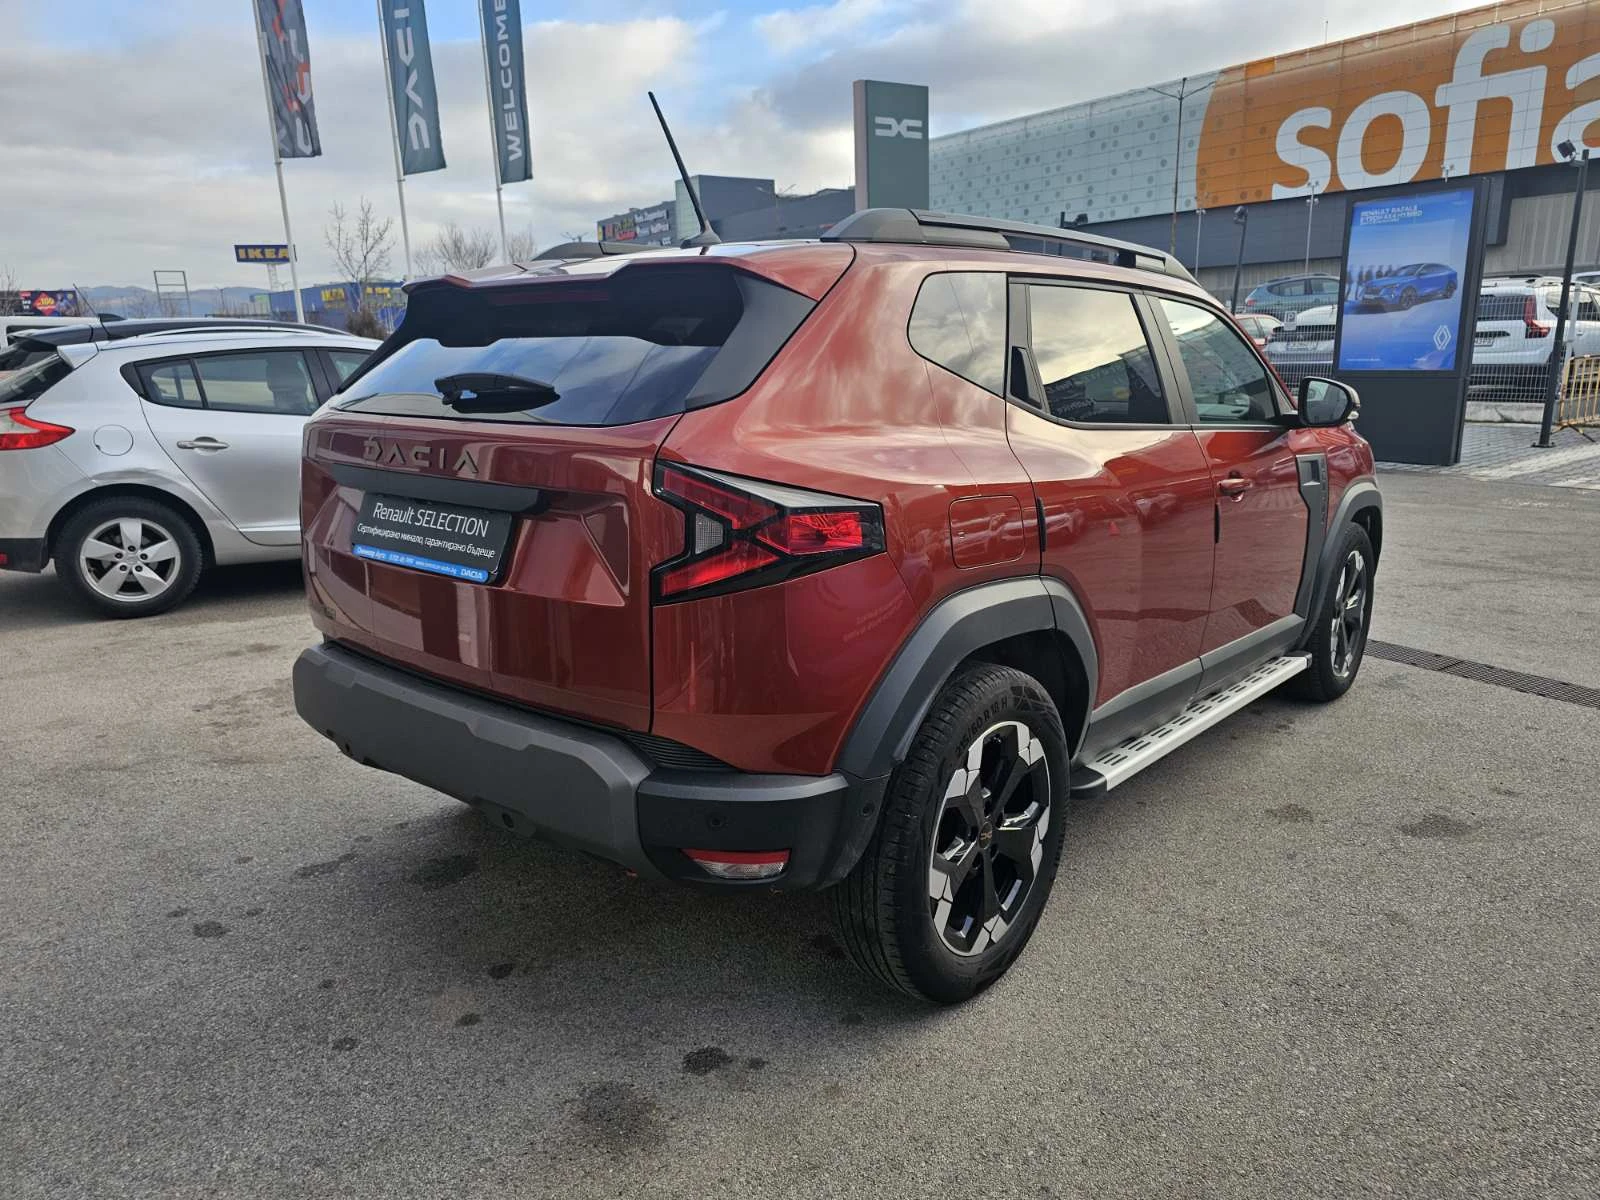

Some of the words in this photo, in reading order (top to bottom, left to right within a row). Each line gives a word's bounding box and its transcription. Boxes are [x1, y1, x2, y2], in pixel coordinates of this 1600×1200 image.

[494, 0, 522, 161] WELCOME
[239, 248, 288, 259] IKEA
[363, 438, 479, 474] DACIA
[373, 502, 415, 525] Renault
[415, 509, 489, 537] SELECTION
[460, 568, 483, 580] DACIA
